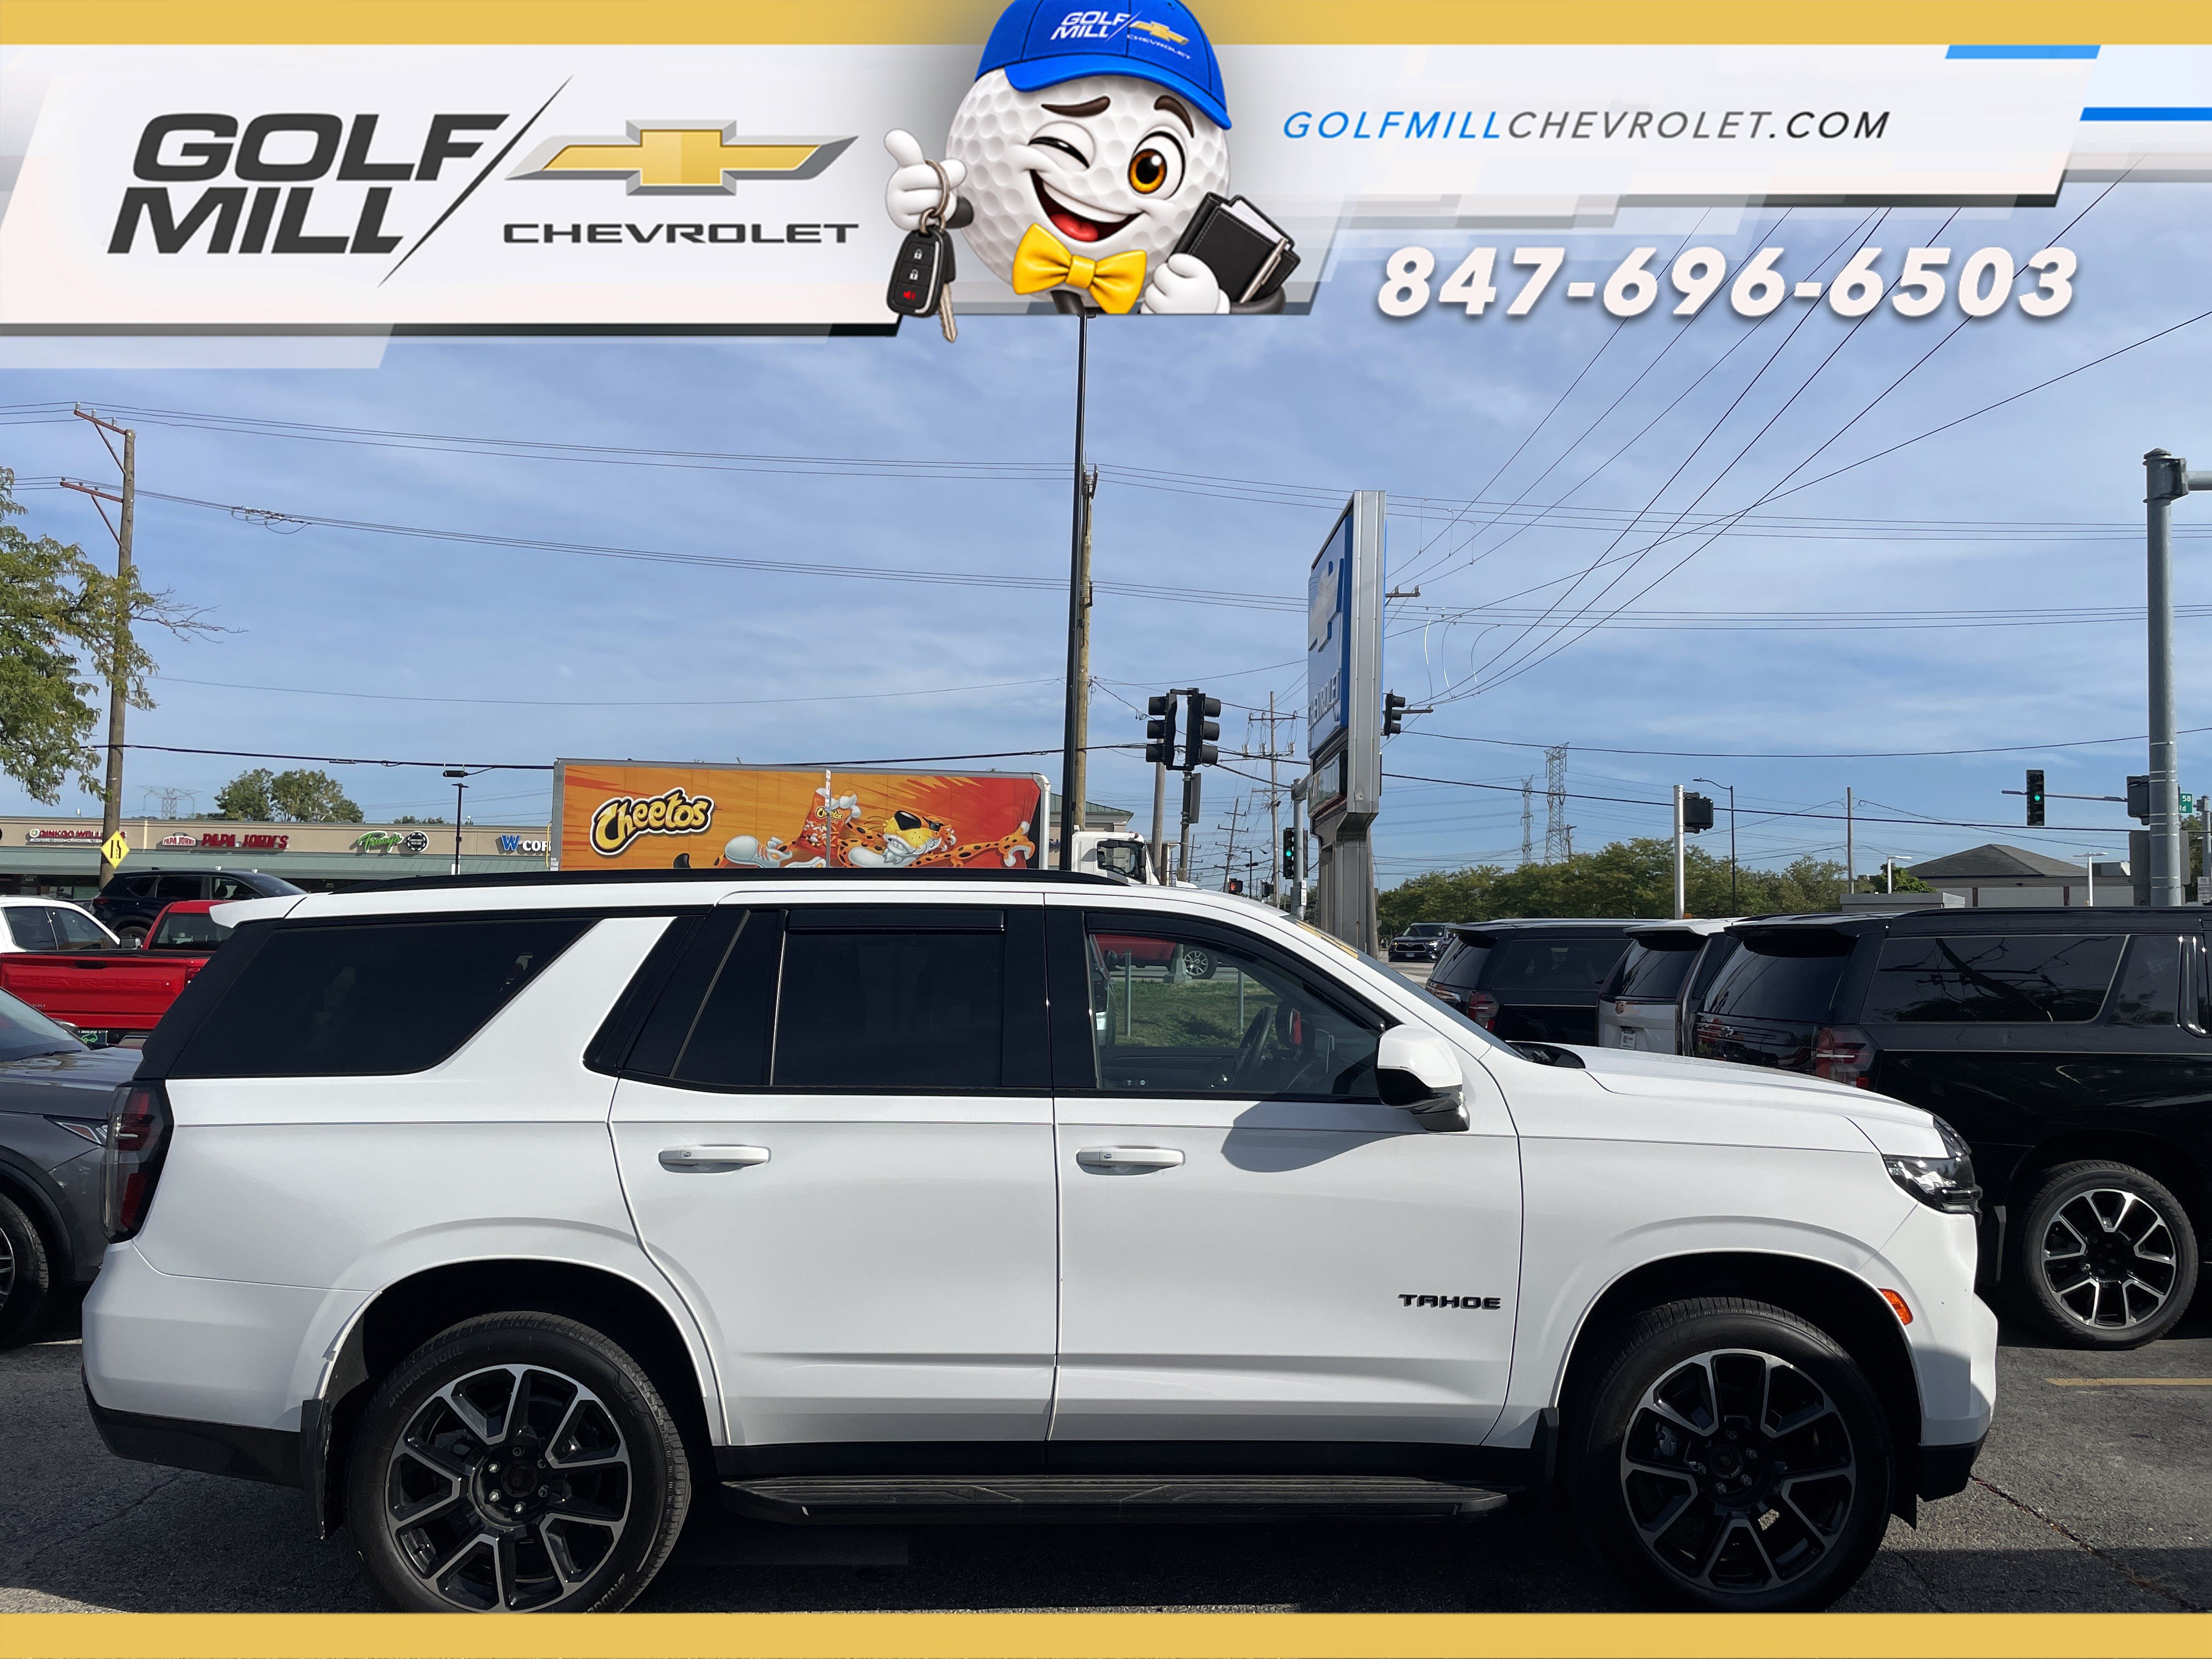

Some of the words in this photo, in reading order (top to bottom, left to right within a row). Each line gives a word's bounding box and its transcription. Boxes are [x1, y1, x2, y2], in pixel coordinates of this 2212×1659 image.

[596, 792, 709, 850] Cheetos
[201, 833, 235, 847] PAPA
[242, 834, 289, 848] JOHN'S
[501, 835, 520, 851] W
[1397, 1294, 1501, 1310] TAHOE
